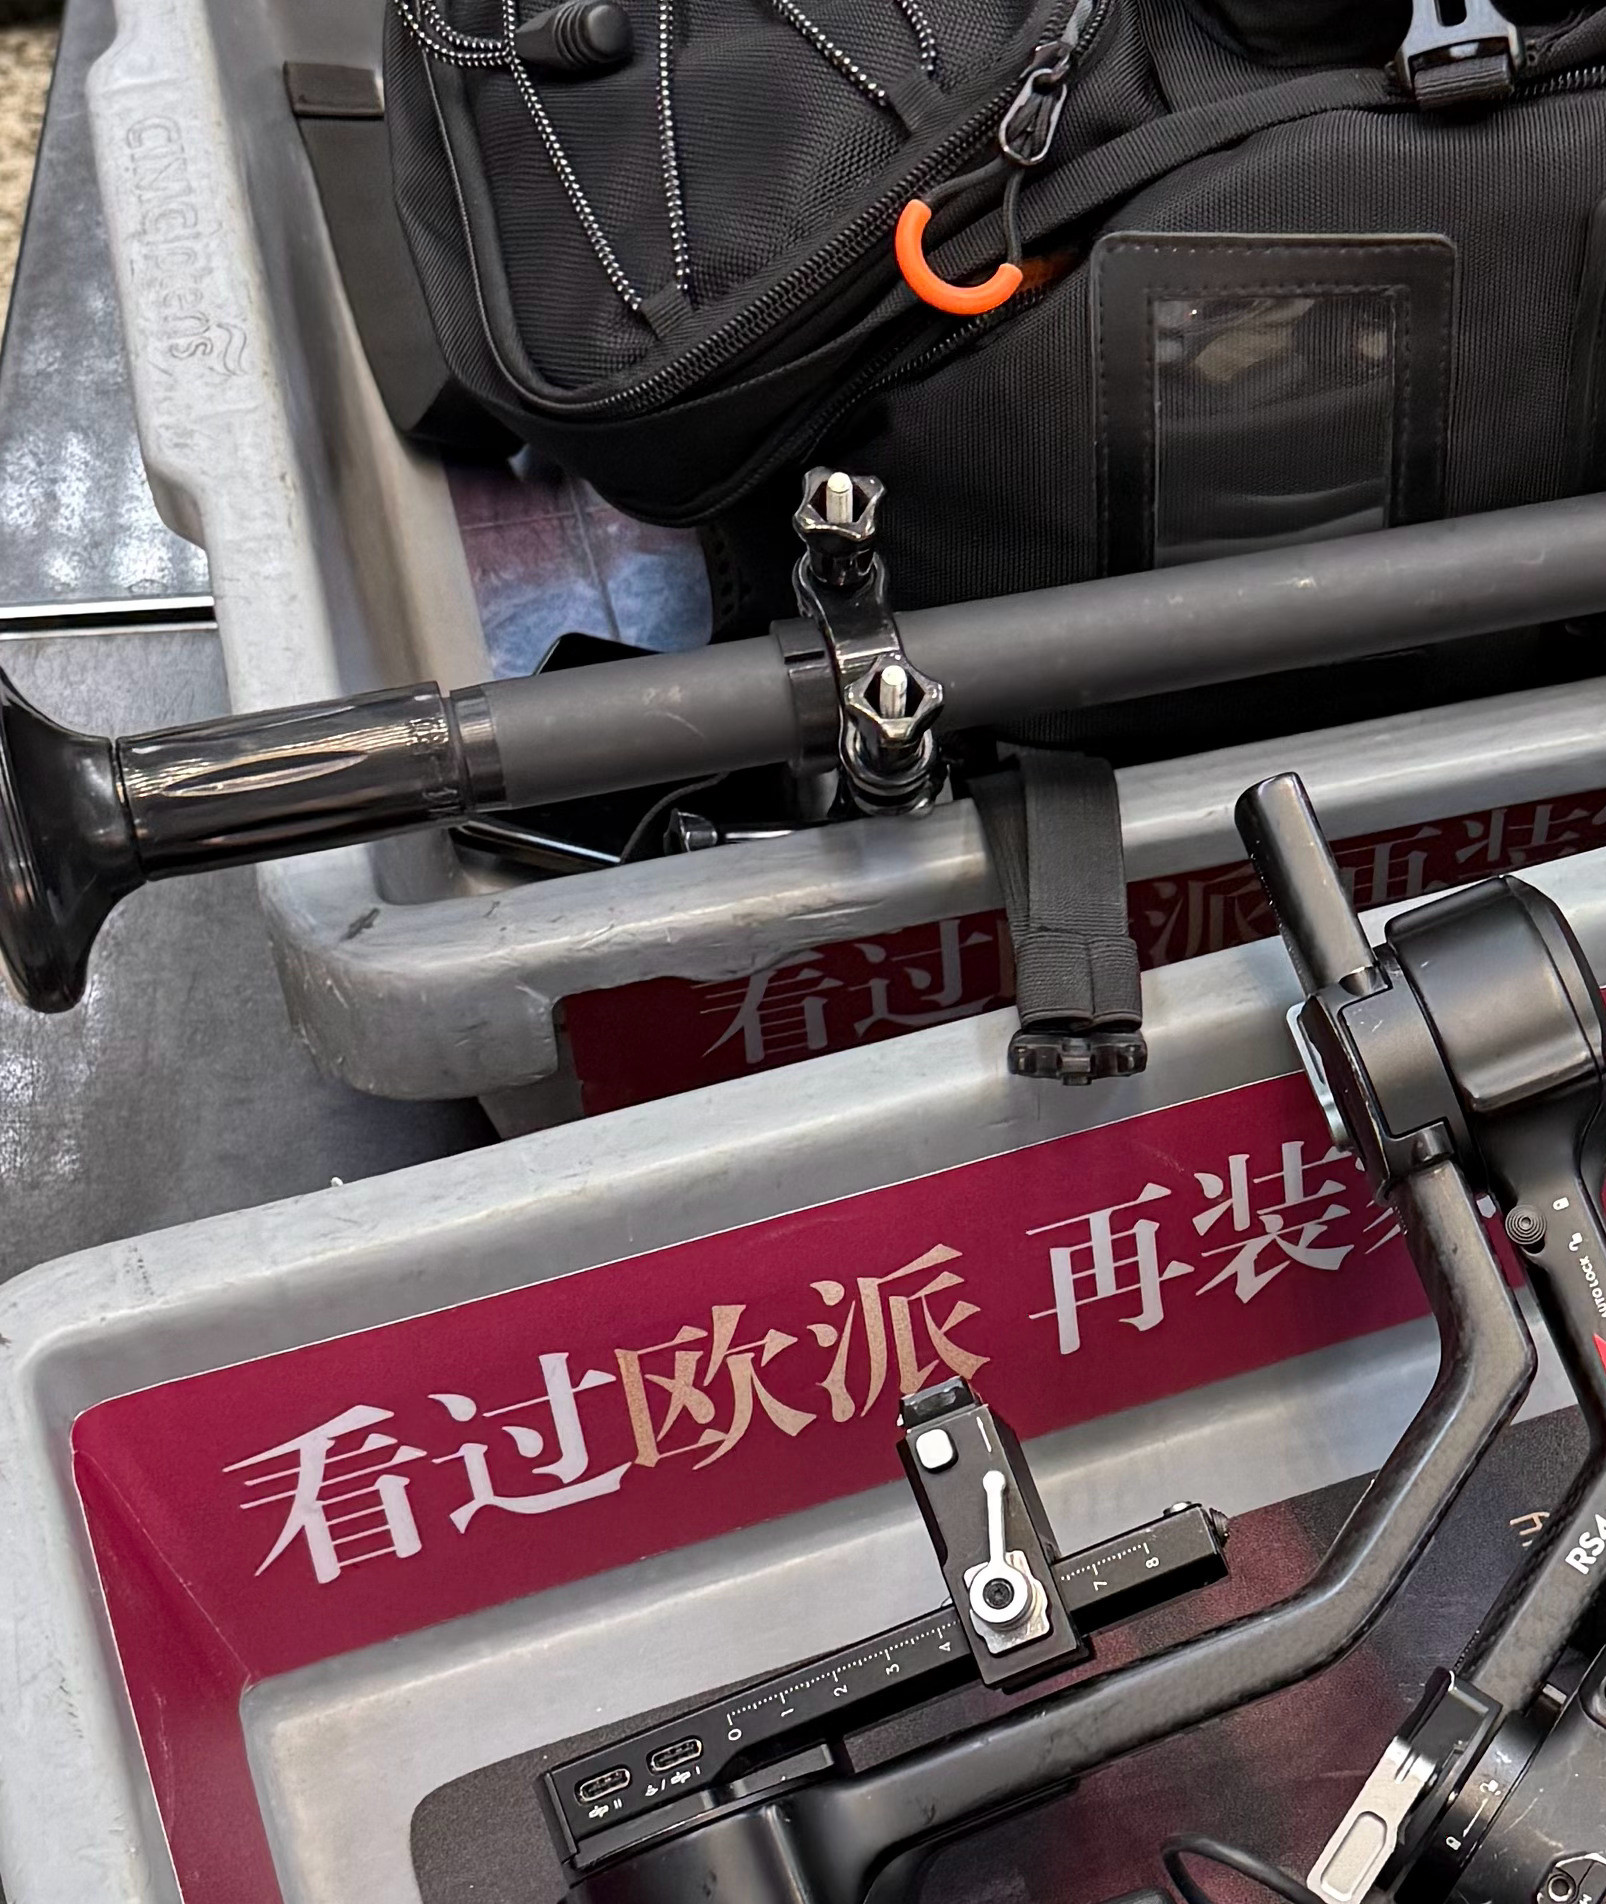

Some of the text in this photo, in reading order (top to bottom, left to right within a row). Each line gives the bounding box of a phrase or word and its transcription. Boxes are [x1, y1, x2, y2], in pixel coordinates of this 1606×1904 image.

[222, 1139, 1410, 1584] 看过欧派 再装
